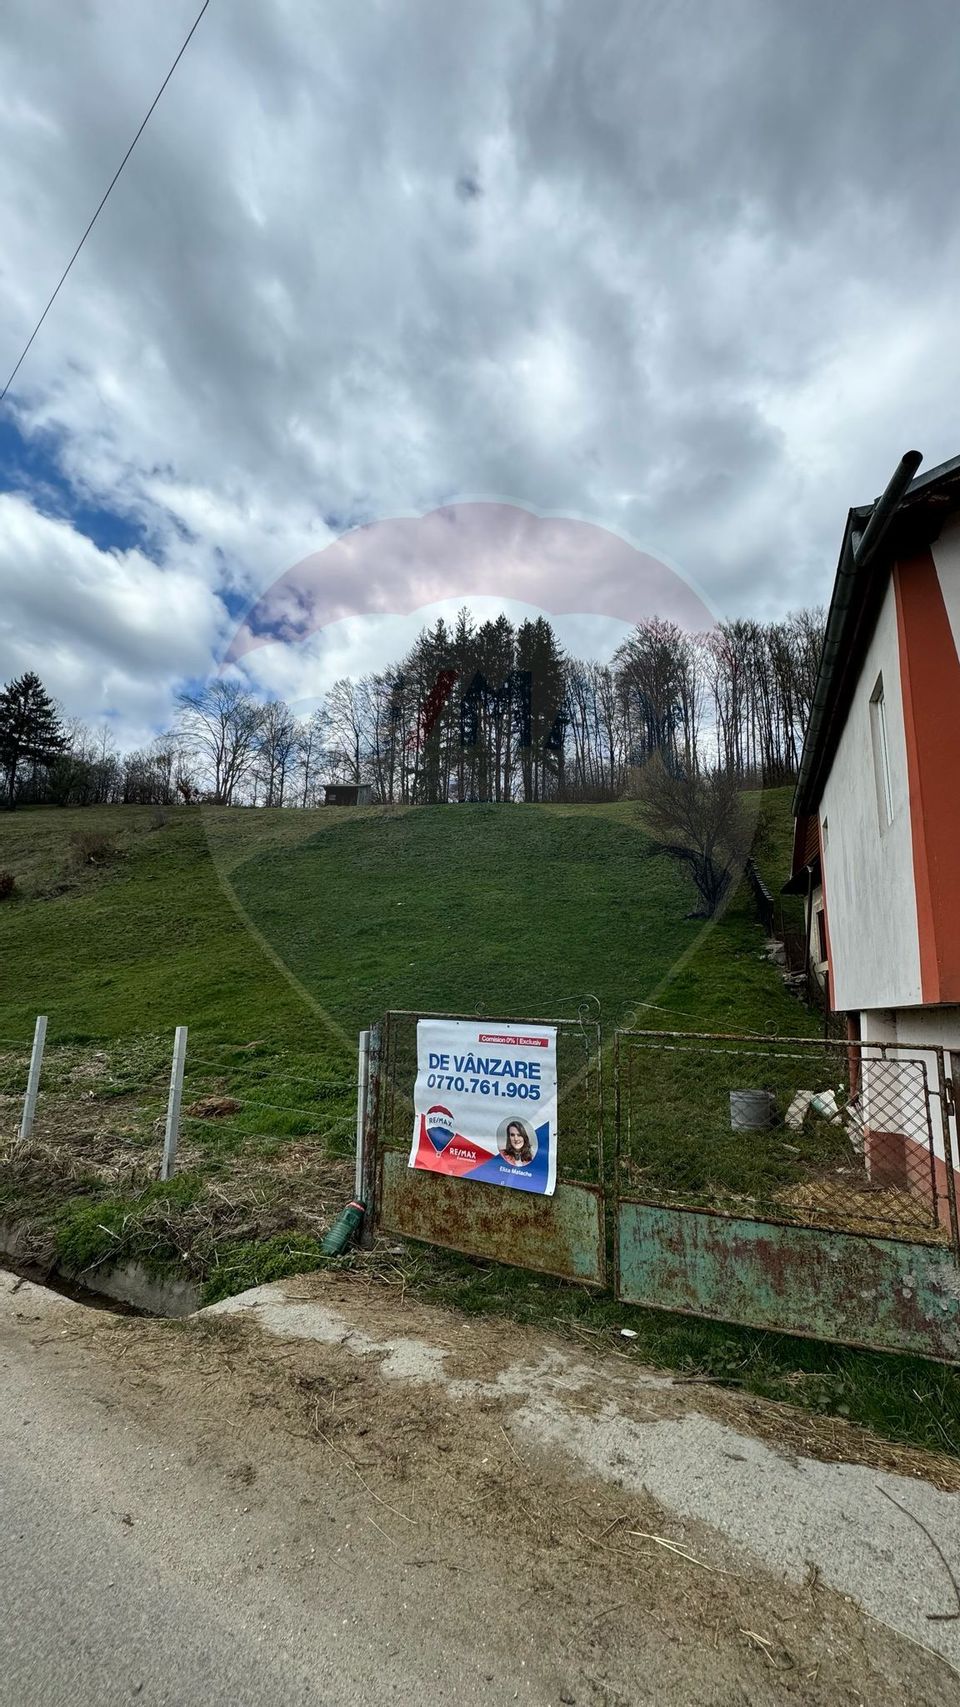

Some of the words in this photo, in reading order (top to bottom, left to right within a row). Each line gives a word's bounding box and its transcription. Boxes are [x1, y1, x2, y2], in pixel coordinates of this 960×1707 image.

[481, 1035, 506, 1043] Comision
[519, 1038, 542, 1046] Exclusiv
[428, 1053, 450, 1071] DE
[453, 1052, 542, 1080] VÂNZARE
[427, 1073, 541, 1101] 0770.761.905
[429, 1116, 453, 1128] RE/MAX
[449, 1147, 477, 1160] RE/MAX
